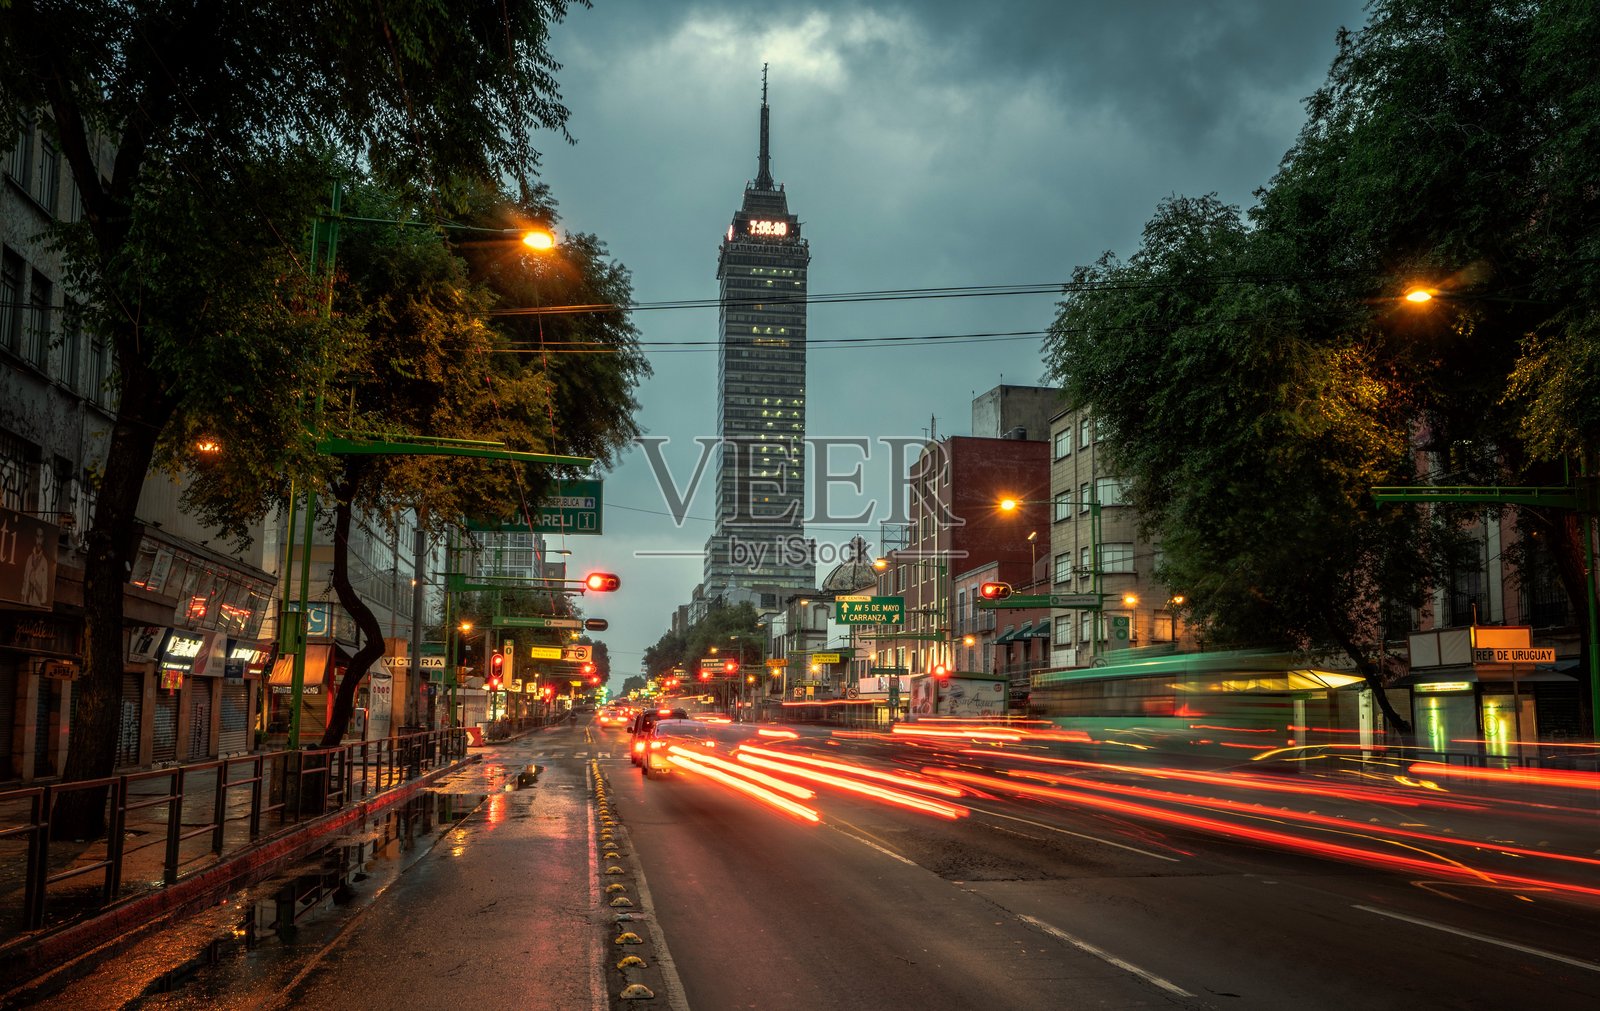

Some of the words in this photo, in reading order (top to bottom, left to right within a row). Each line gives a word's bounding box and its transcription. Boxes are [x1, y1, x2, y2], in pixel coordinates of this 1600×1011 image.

[854, 604, 862, 612] AV
[865, 604, 869, 612] 5
[872, 604, 880, 612] DE
[882, 604, 900, 612] MAYO
[1476, 650, 1494, 661] REP
[1497, 650, 1509, 661] DE
[1512, 650, 1553, 661] URUGUAY
[383, 658, 443, 666] VICTRIA
